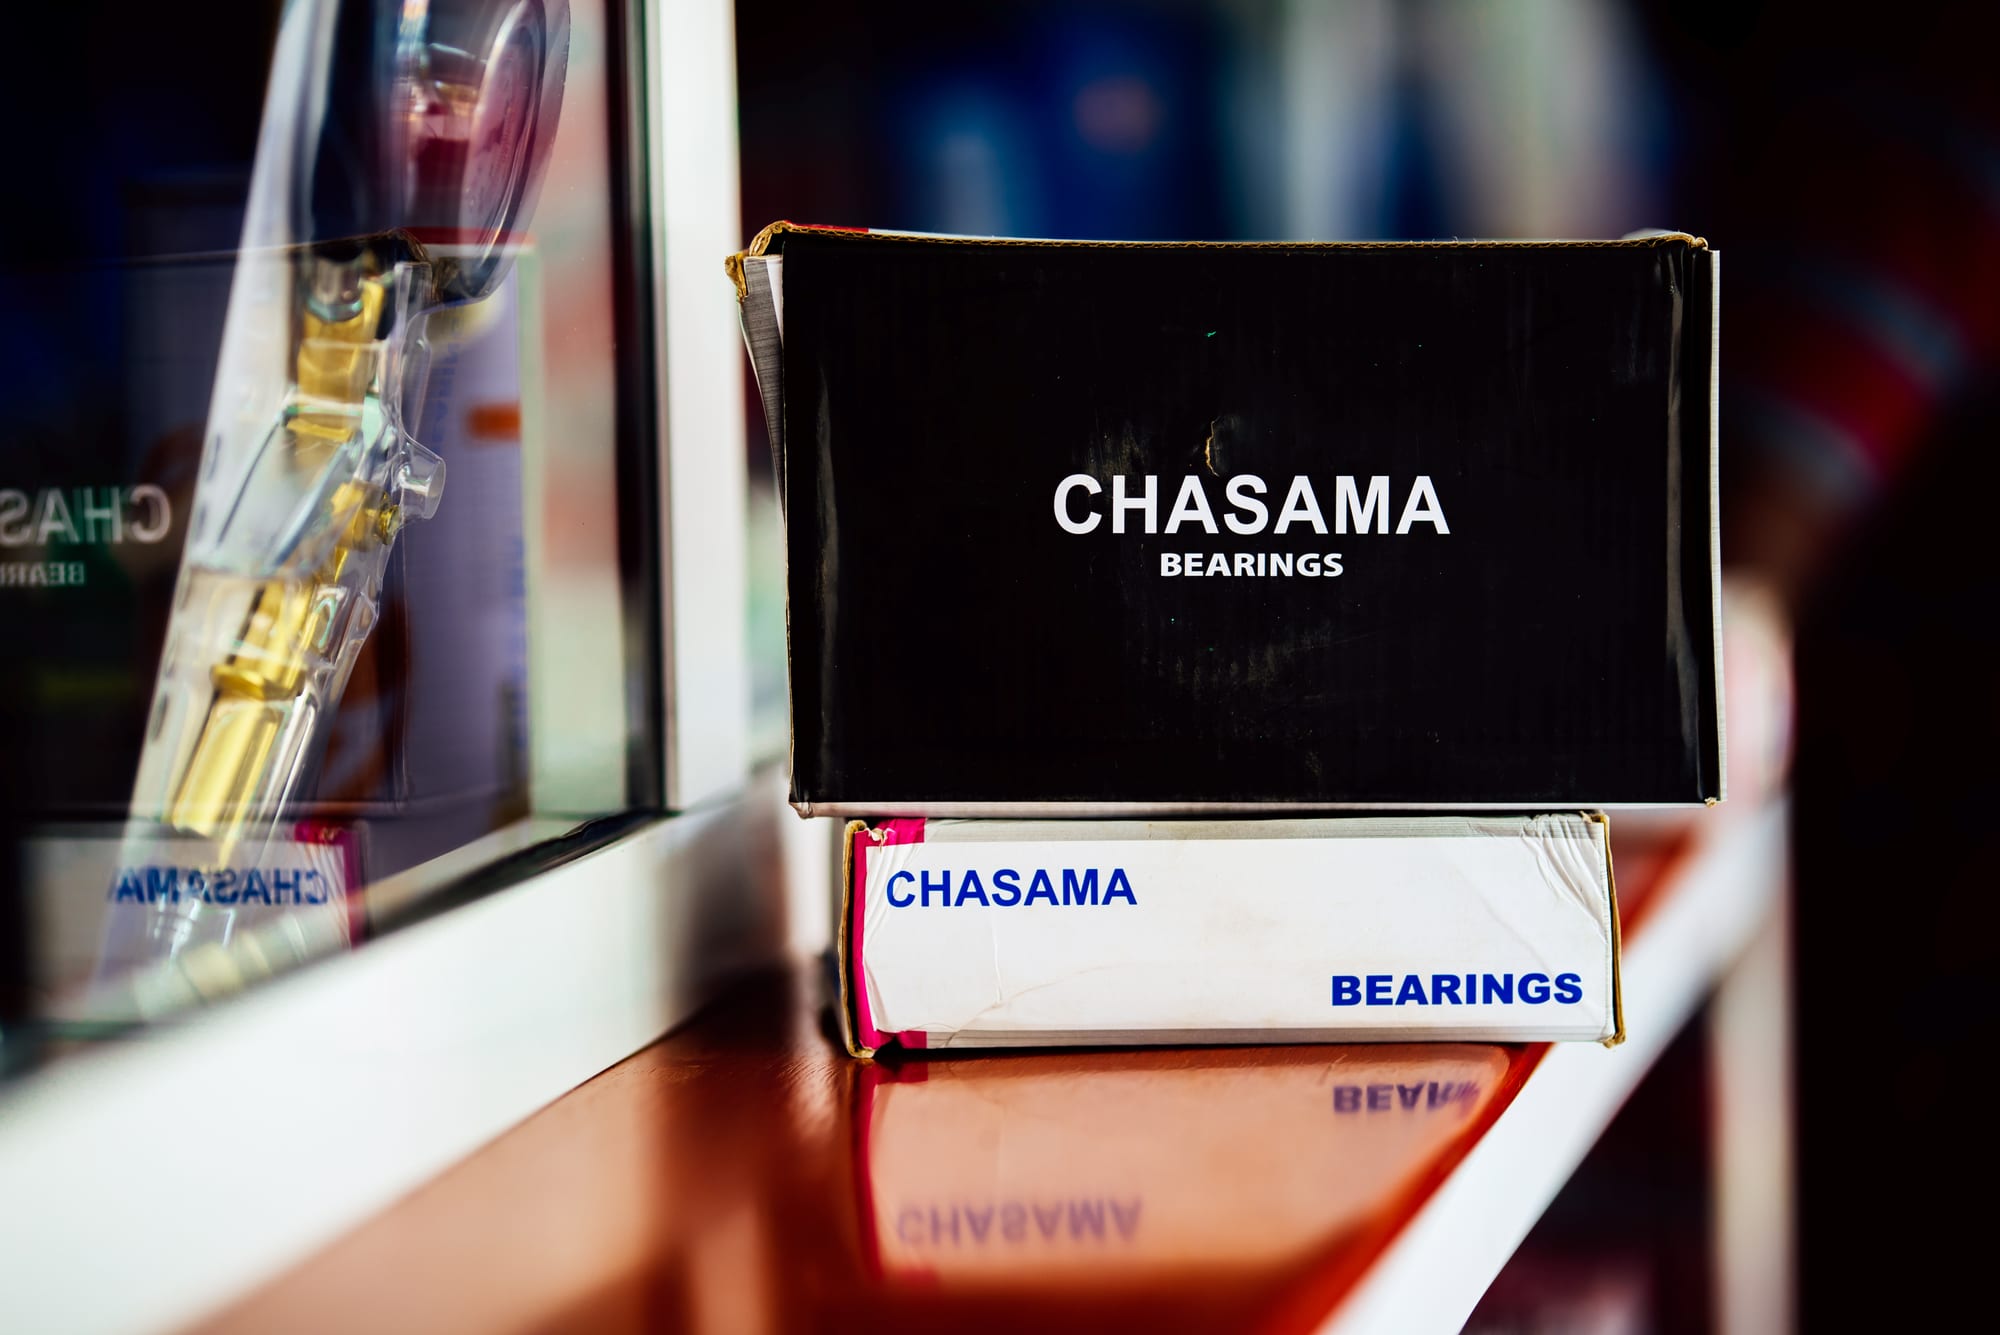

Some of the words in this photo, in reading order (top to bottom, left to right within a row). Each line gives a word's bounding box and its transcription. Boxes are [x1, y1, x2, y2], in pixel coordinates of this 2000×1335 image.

[1053, 473, 1451, 535] CHASAMA
[1160, 552, 1344, 577] BEARINGS
[885, 868, 1137, 908] CHASAMA
[1331, 972, 1583, 1006] BEARINGS
